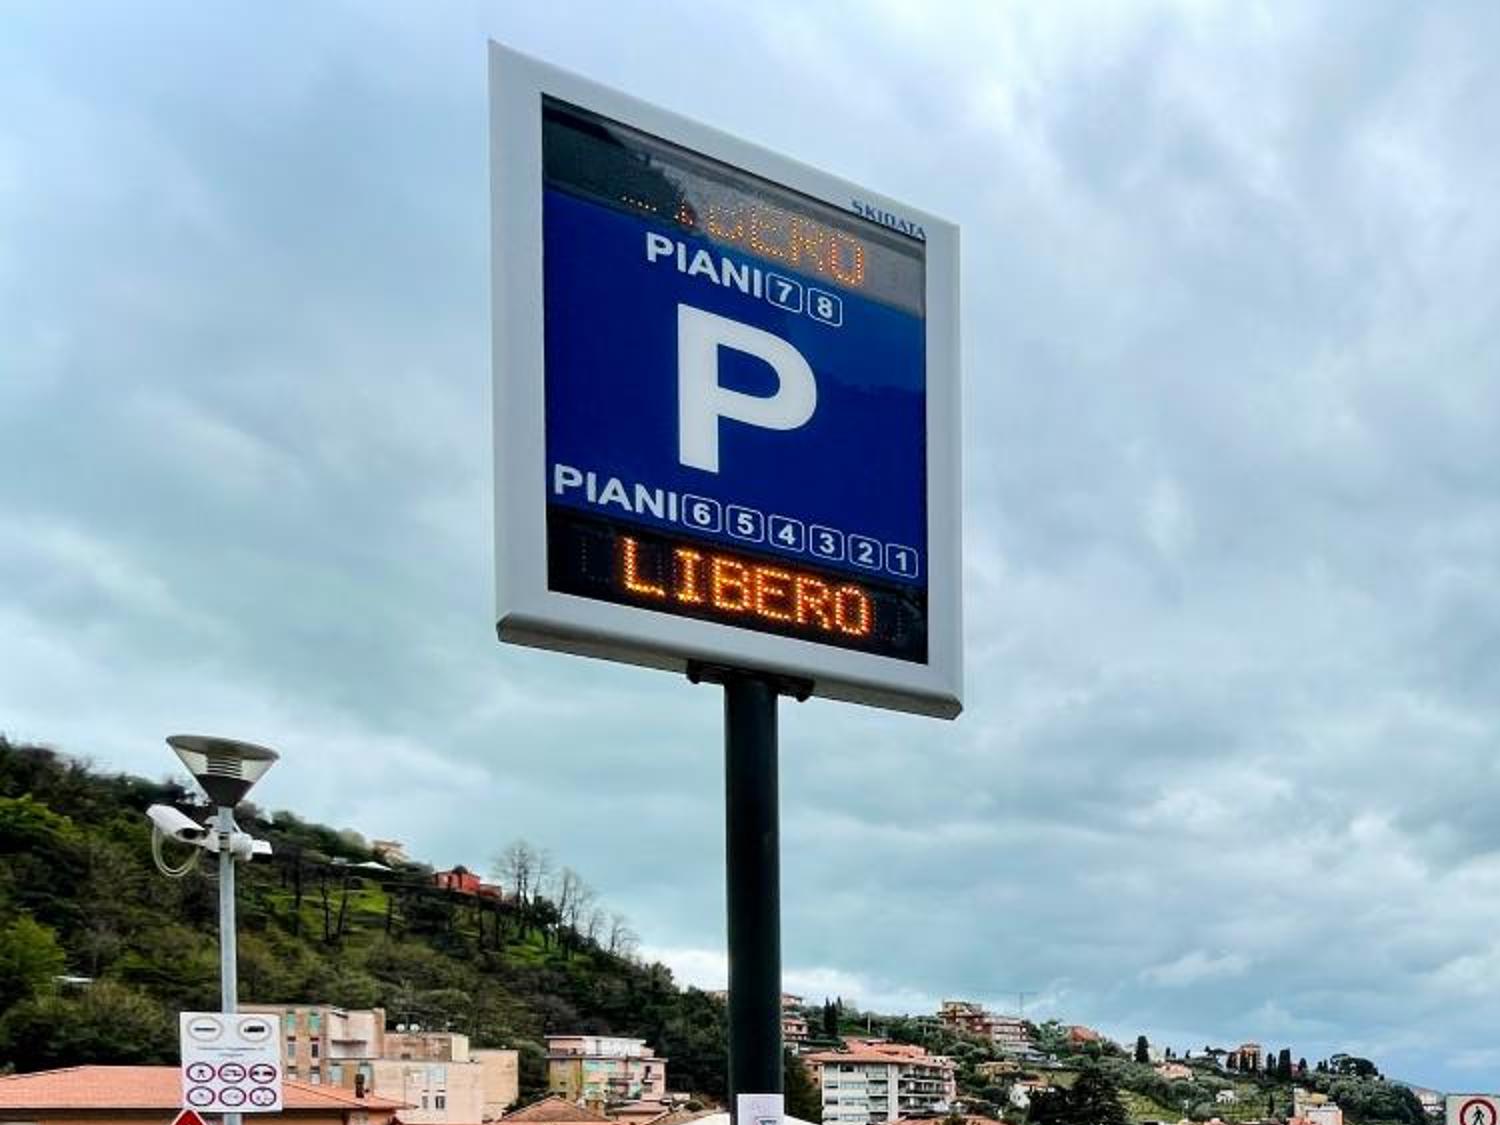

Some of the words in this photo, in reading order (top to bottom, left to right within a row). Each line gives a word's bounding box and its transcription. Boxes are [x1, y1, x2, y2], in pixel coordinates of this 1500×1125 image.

[622, 196, 865, 287] BERO
[851, 200, 926, 240] SKIDATA
[646, 231, 762, 298] PIANI
[776, 281, 793, 304] 7
[818, 296, 833, 319] 8
[678, 303, 818, 473] P
[554, 463, 677, 522] PIANI
[693, 501, 712, 527] 6
[737, 512, 755, 536] 5
[778, 522, 795, 546] 4
[820, 532, 835, 555] 3
[858, 541, 873, 564] 2
[896, 550, 908, 572] 1
[621, 536, 872, 636] LIBERO
